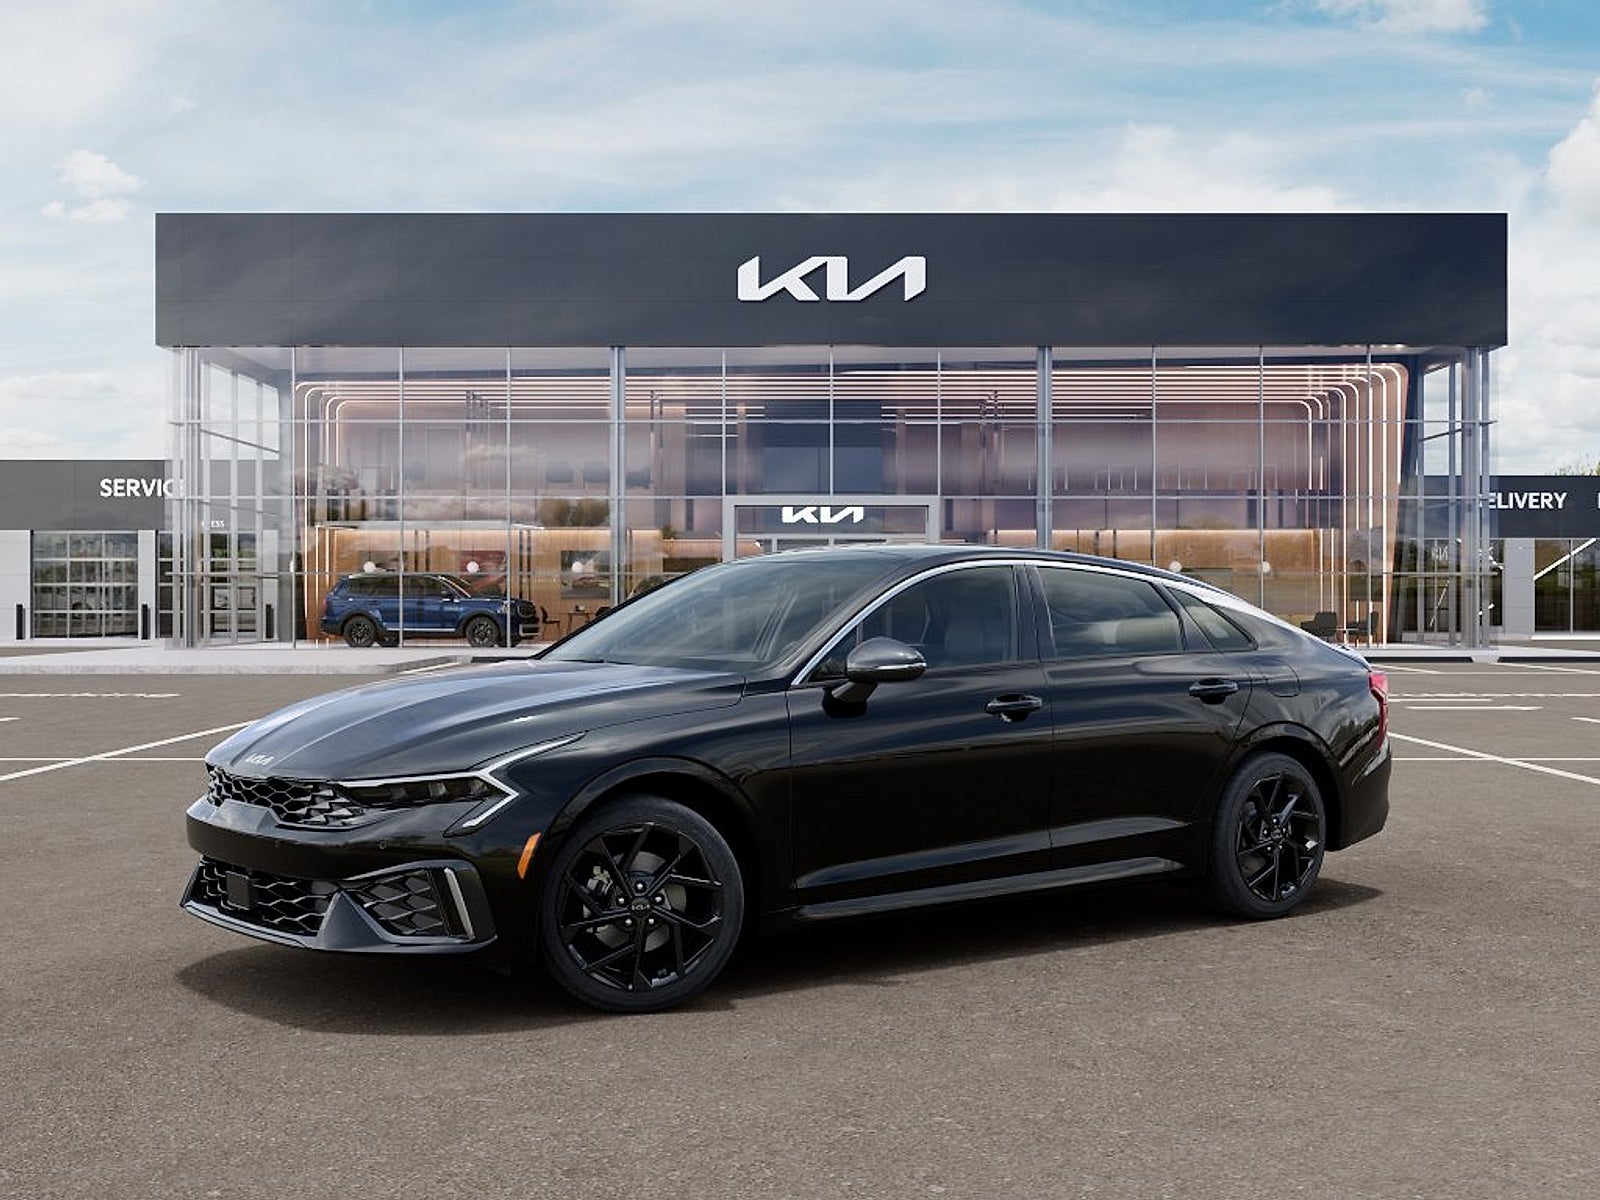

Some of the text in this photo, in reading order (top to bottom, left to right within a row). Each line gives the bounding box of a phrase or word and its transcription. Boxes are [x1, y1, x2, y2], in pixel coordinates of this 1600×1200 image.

[737, 256, 926, 301] KIA
[1479, 492, 1567, 509] ELIVERY
[782, 506, 864, 523] KIA
